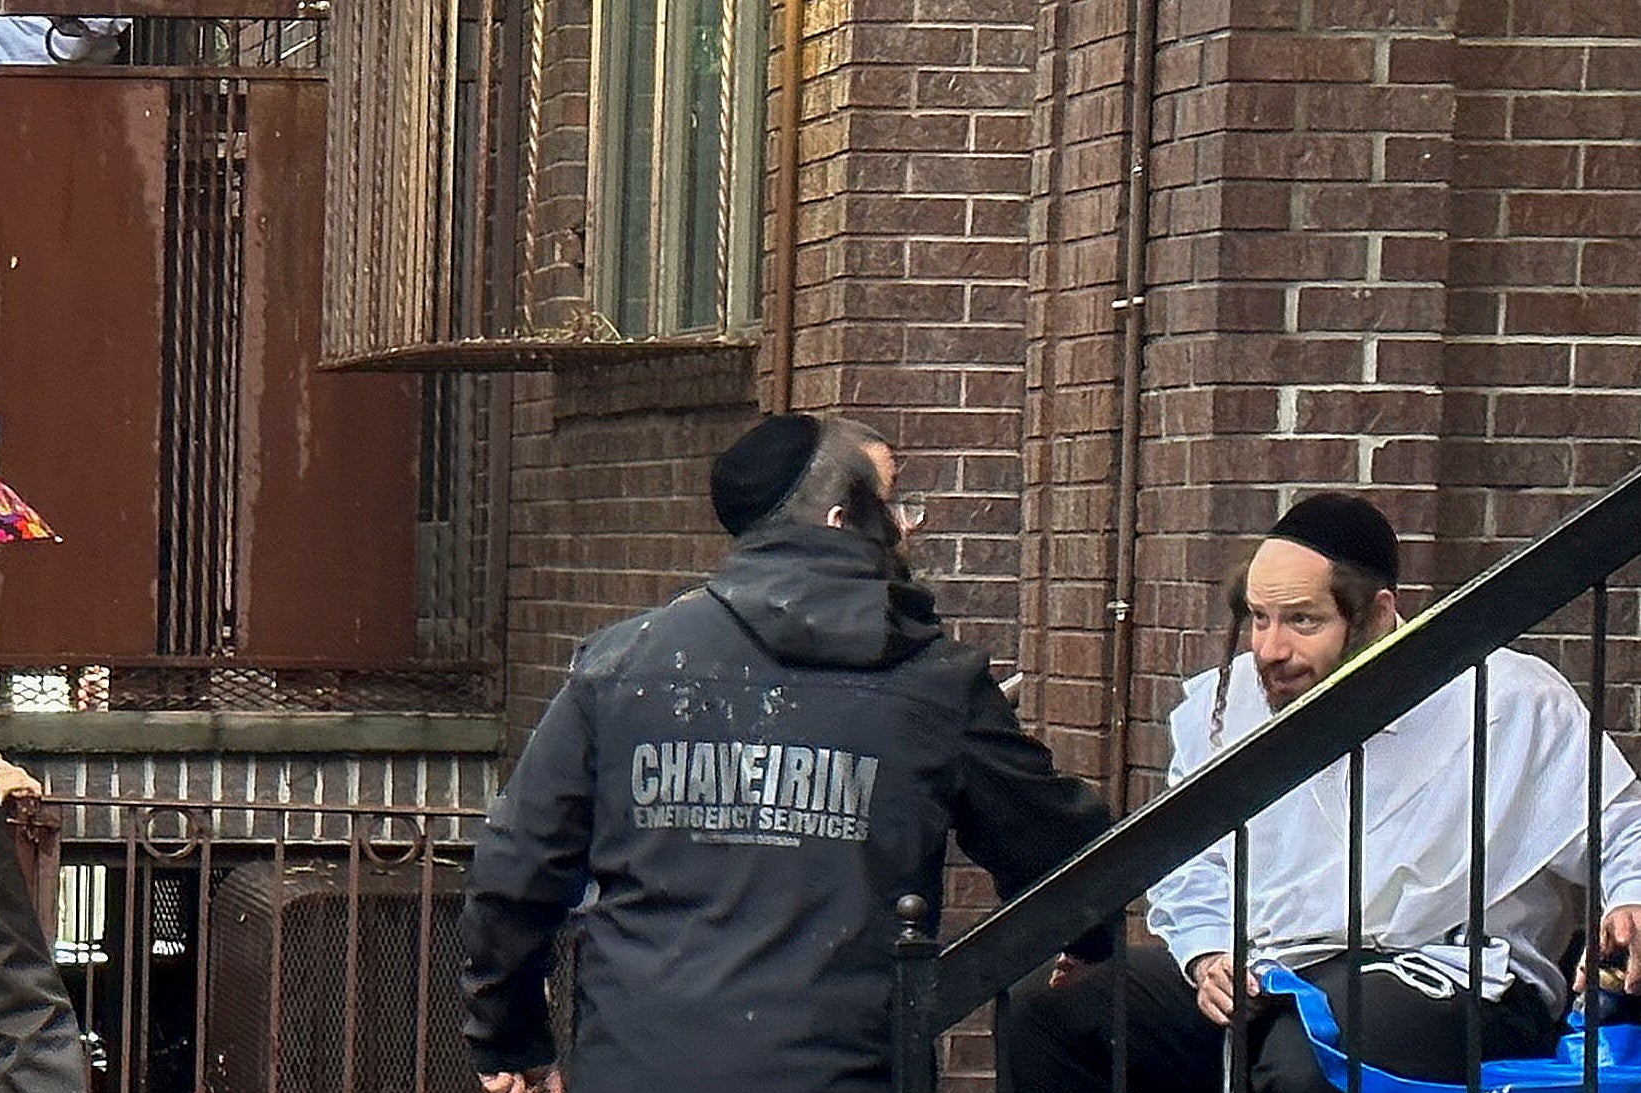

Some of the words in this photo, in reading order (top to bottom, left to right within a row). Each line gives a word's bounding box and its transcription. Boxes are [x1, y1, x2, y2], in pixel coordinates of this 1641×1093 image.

[631, 742, 879, 817] CHAVEIRIM
[633, 804, 753, 830] EMERGENCY
[758, 806, 869, 841] SERVICES
